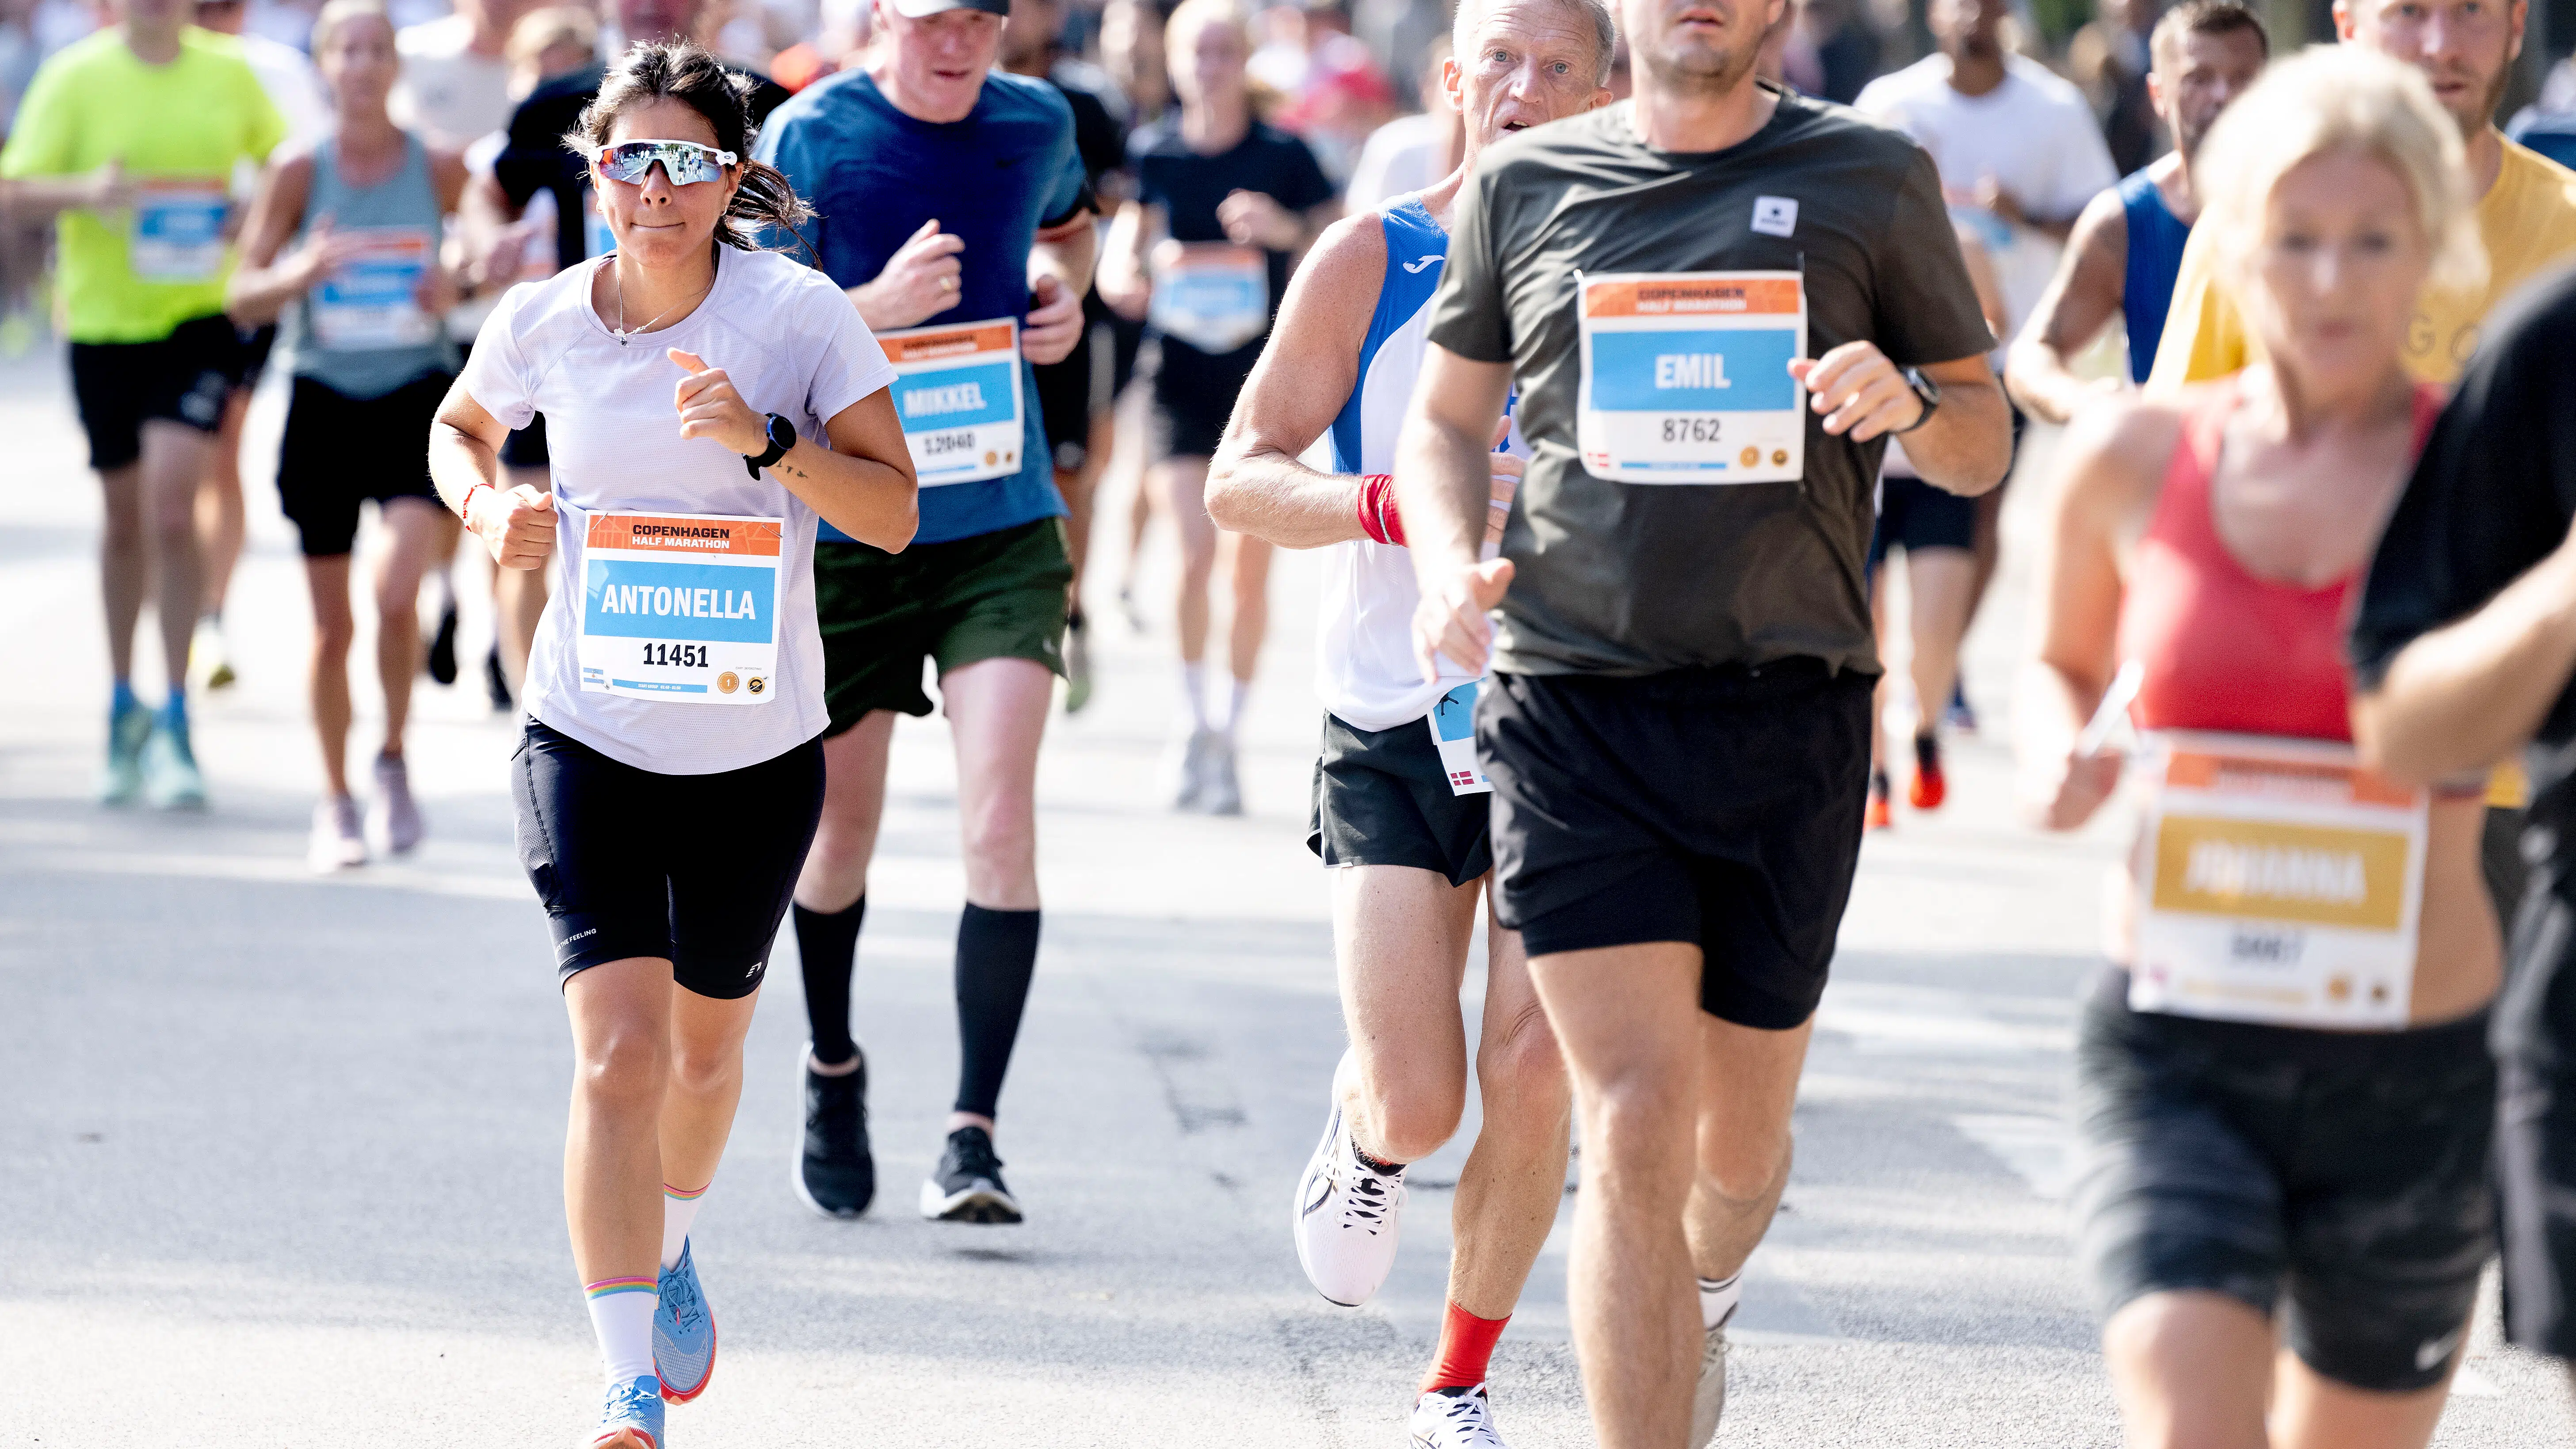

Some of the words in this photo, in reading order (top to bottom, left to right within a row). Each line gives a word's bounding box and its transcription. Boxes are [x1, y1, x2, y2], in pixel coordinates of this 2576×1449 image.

[1655, 354, 1731, 389] EMIL
[904, 382, 987, 418] MIKKEL
[1662, 418, 1721, 442] 8762
[632, 536, 662, 545] HALF
[664, 538, 729, 549] MARATHON
[633, 525, 729, 538] COPENHAGEN
[601, 584, 756, 620] ANTONELLA
[643, 643, 708, 667] 11451
[560, 938, 569, 947] THE
[569, 928, 596, 942] FEELING
